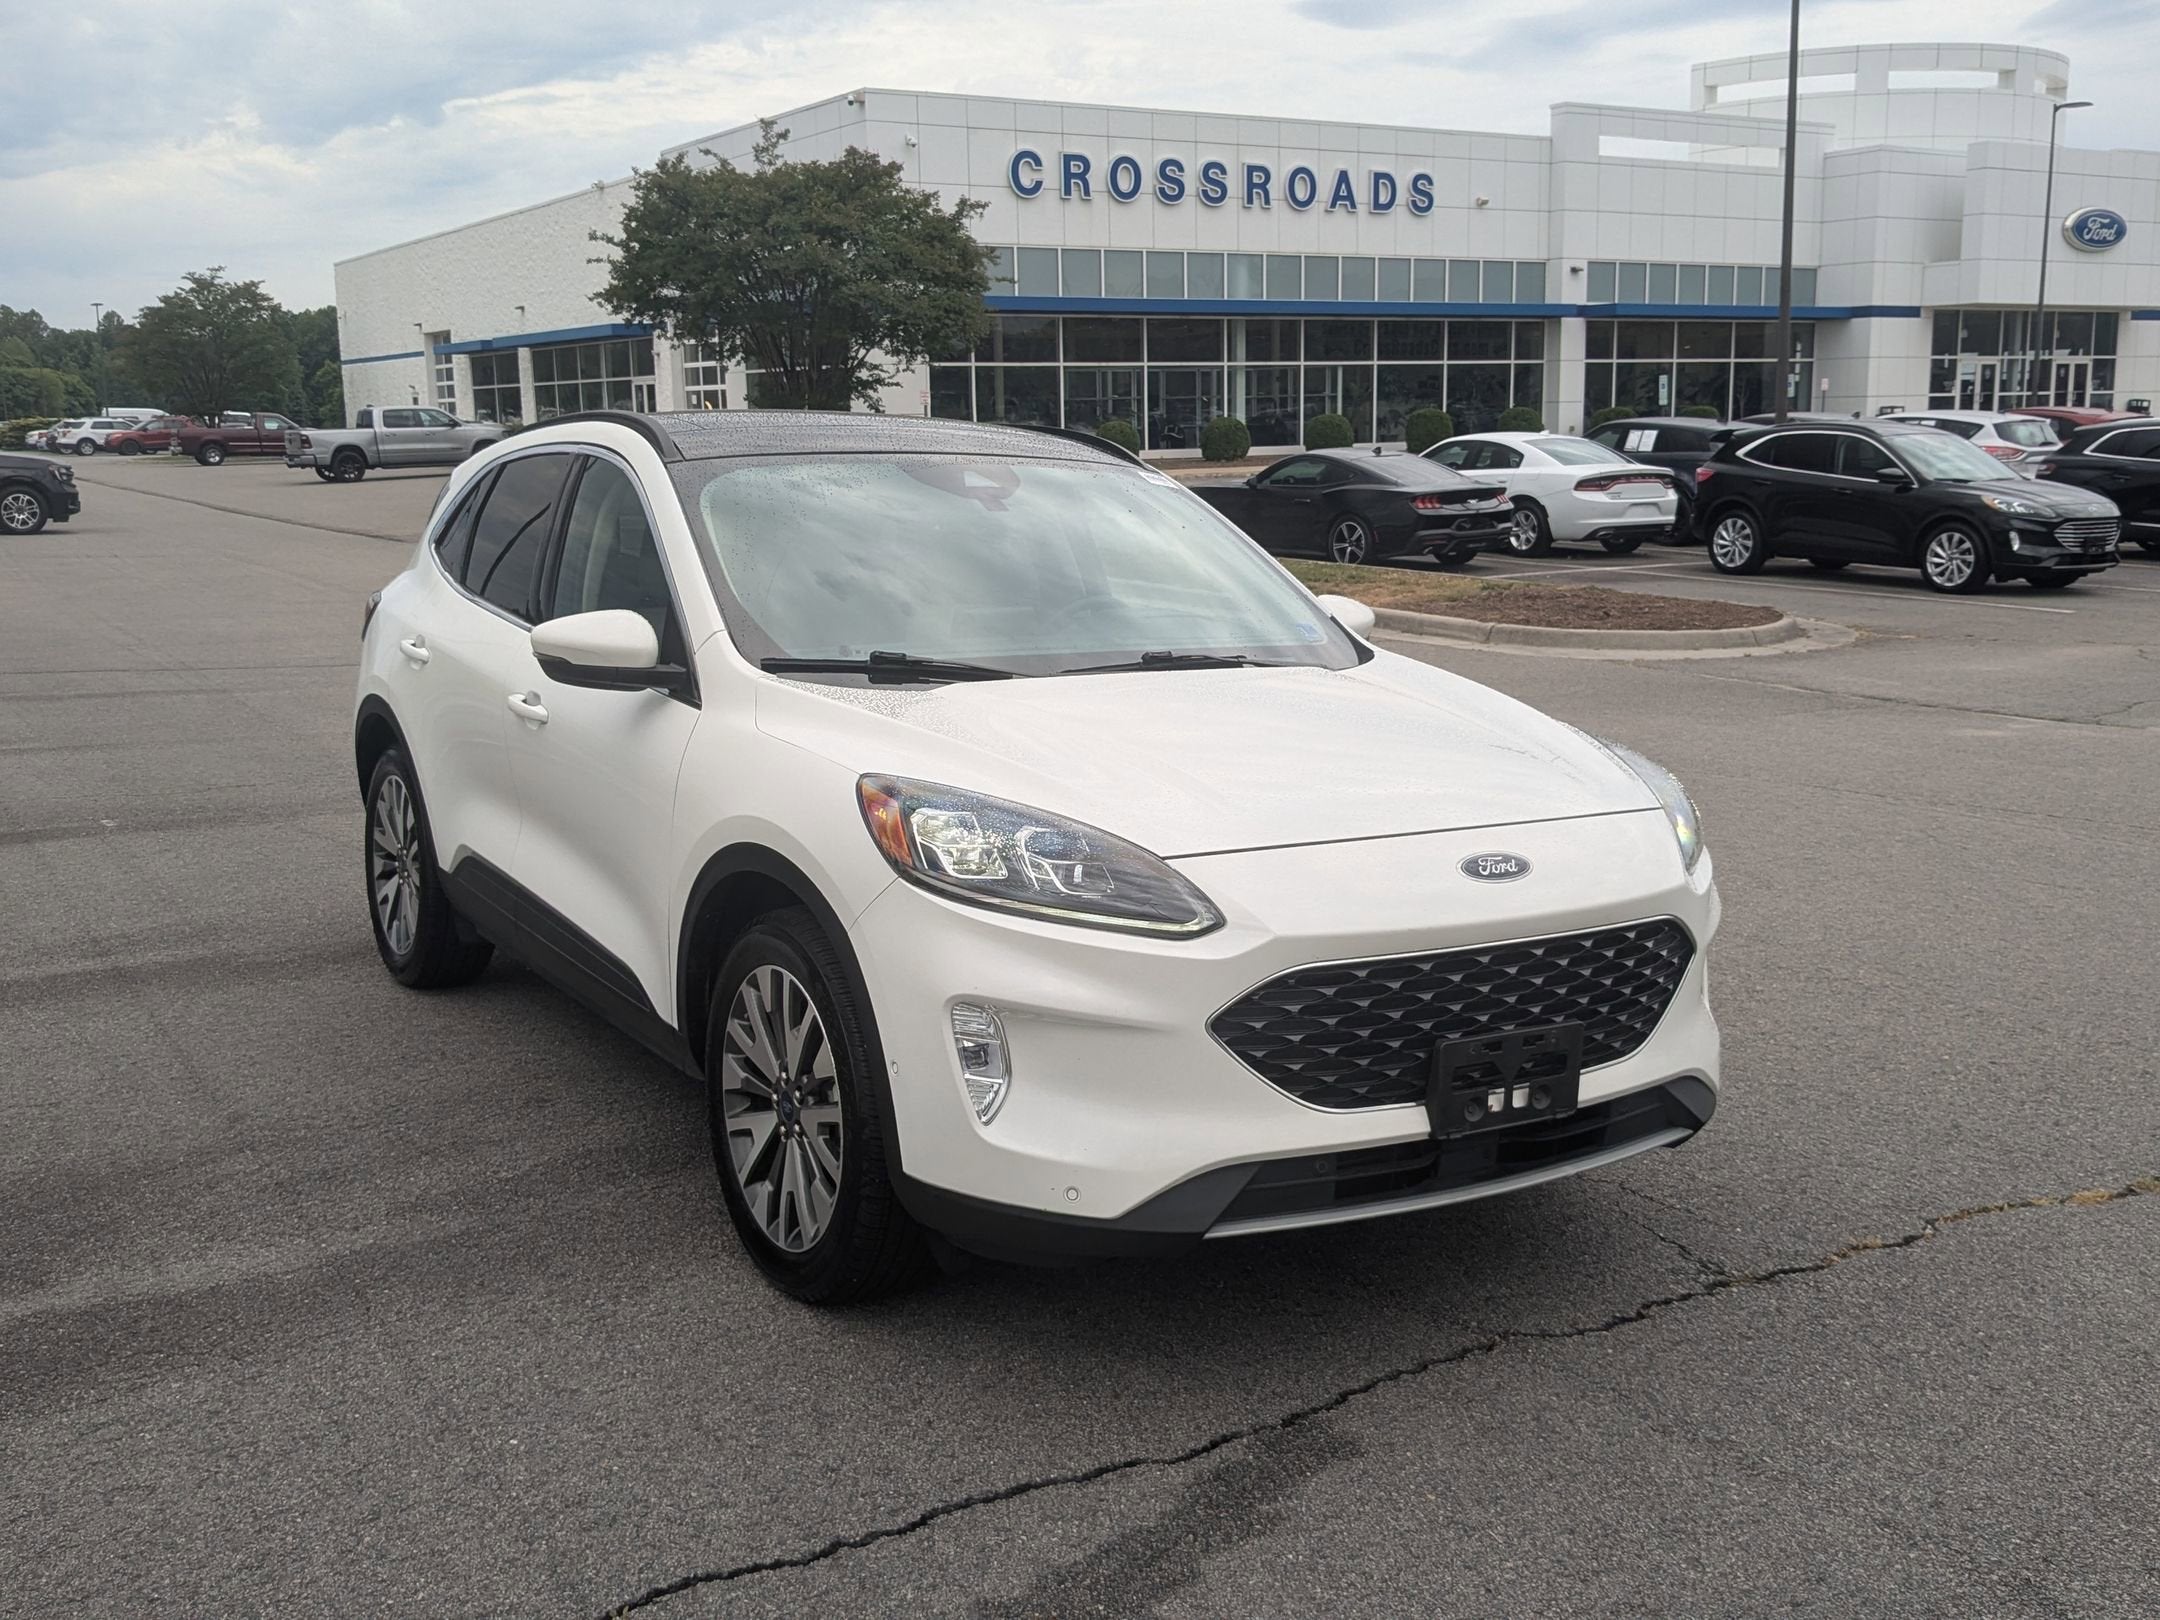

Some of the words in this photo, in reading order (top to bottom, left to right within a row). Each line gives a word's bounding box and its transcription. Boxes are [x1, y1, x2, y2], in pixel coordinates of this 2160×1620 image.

[1008, 149, 1436, 216] CROSSROADS
[2083, 216, 2119, 240] Ford
[1478, 856, 1518, 876] Ford
